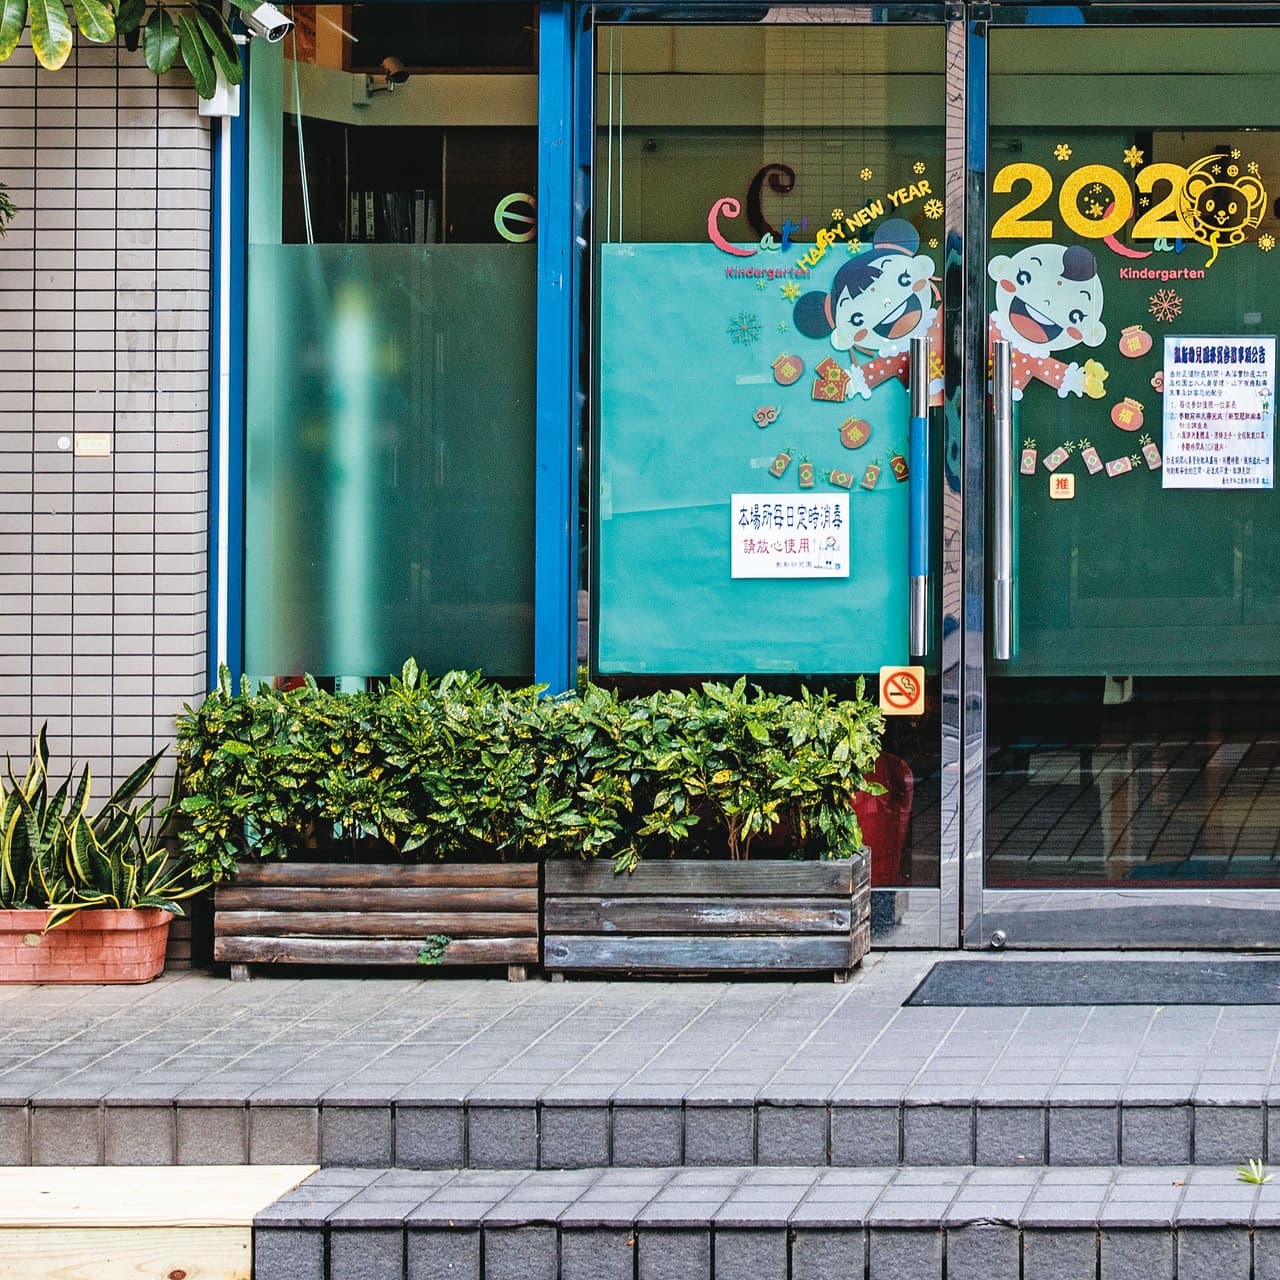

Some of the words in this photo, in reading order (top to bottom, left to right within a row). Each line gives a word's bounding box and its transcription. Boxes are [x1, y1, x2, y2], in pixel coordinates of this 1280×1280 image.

[796, 223, 846, 271] HAPPY
[846, 199, 885, 232] NEW
[887, 180, 932, 207] YEAR
[725, 266, 810, 280] Kindergarten
[1119, 268, 1205, 281] Kindergarten
[1056, 477, 1070, 490] 推
[739, 504, 842, 530] 本場所每日定時消毒
